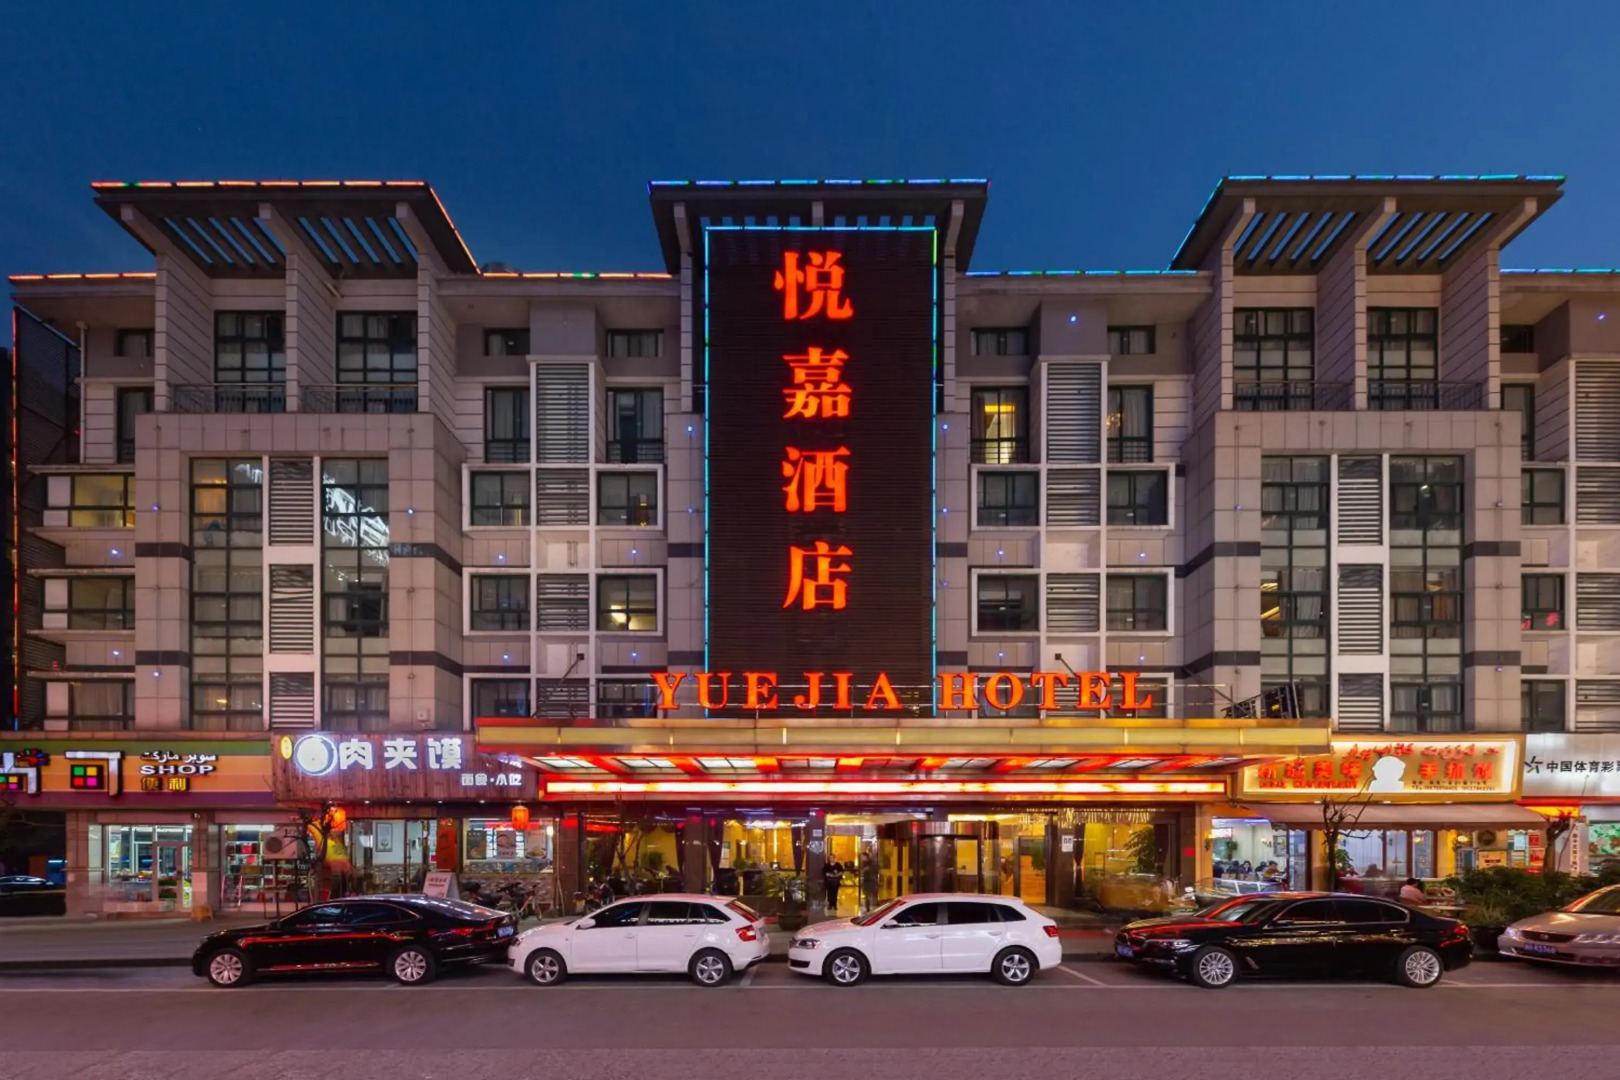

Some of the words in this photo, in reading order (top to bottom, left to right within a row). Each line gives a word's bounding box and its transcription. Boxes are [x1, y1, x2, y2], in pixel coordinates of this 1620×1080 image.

[773, 249, 856, 612] 悦嘉酒店
[937, 671, 1155, 711] HOTEL
[140, 764, 214, 775] SHOP
[340, 738, 462, 770] 肉夹馍
